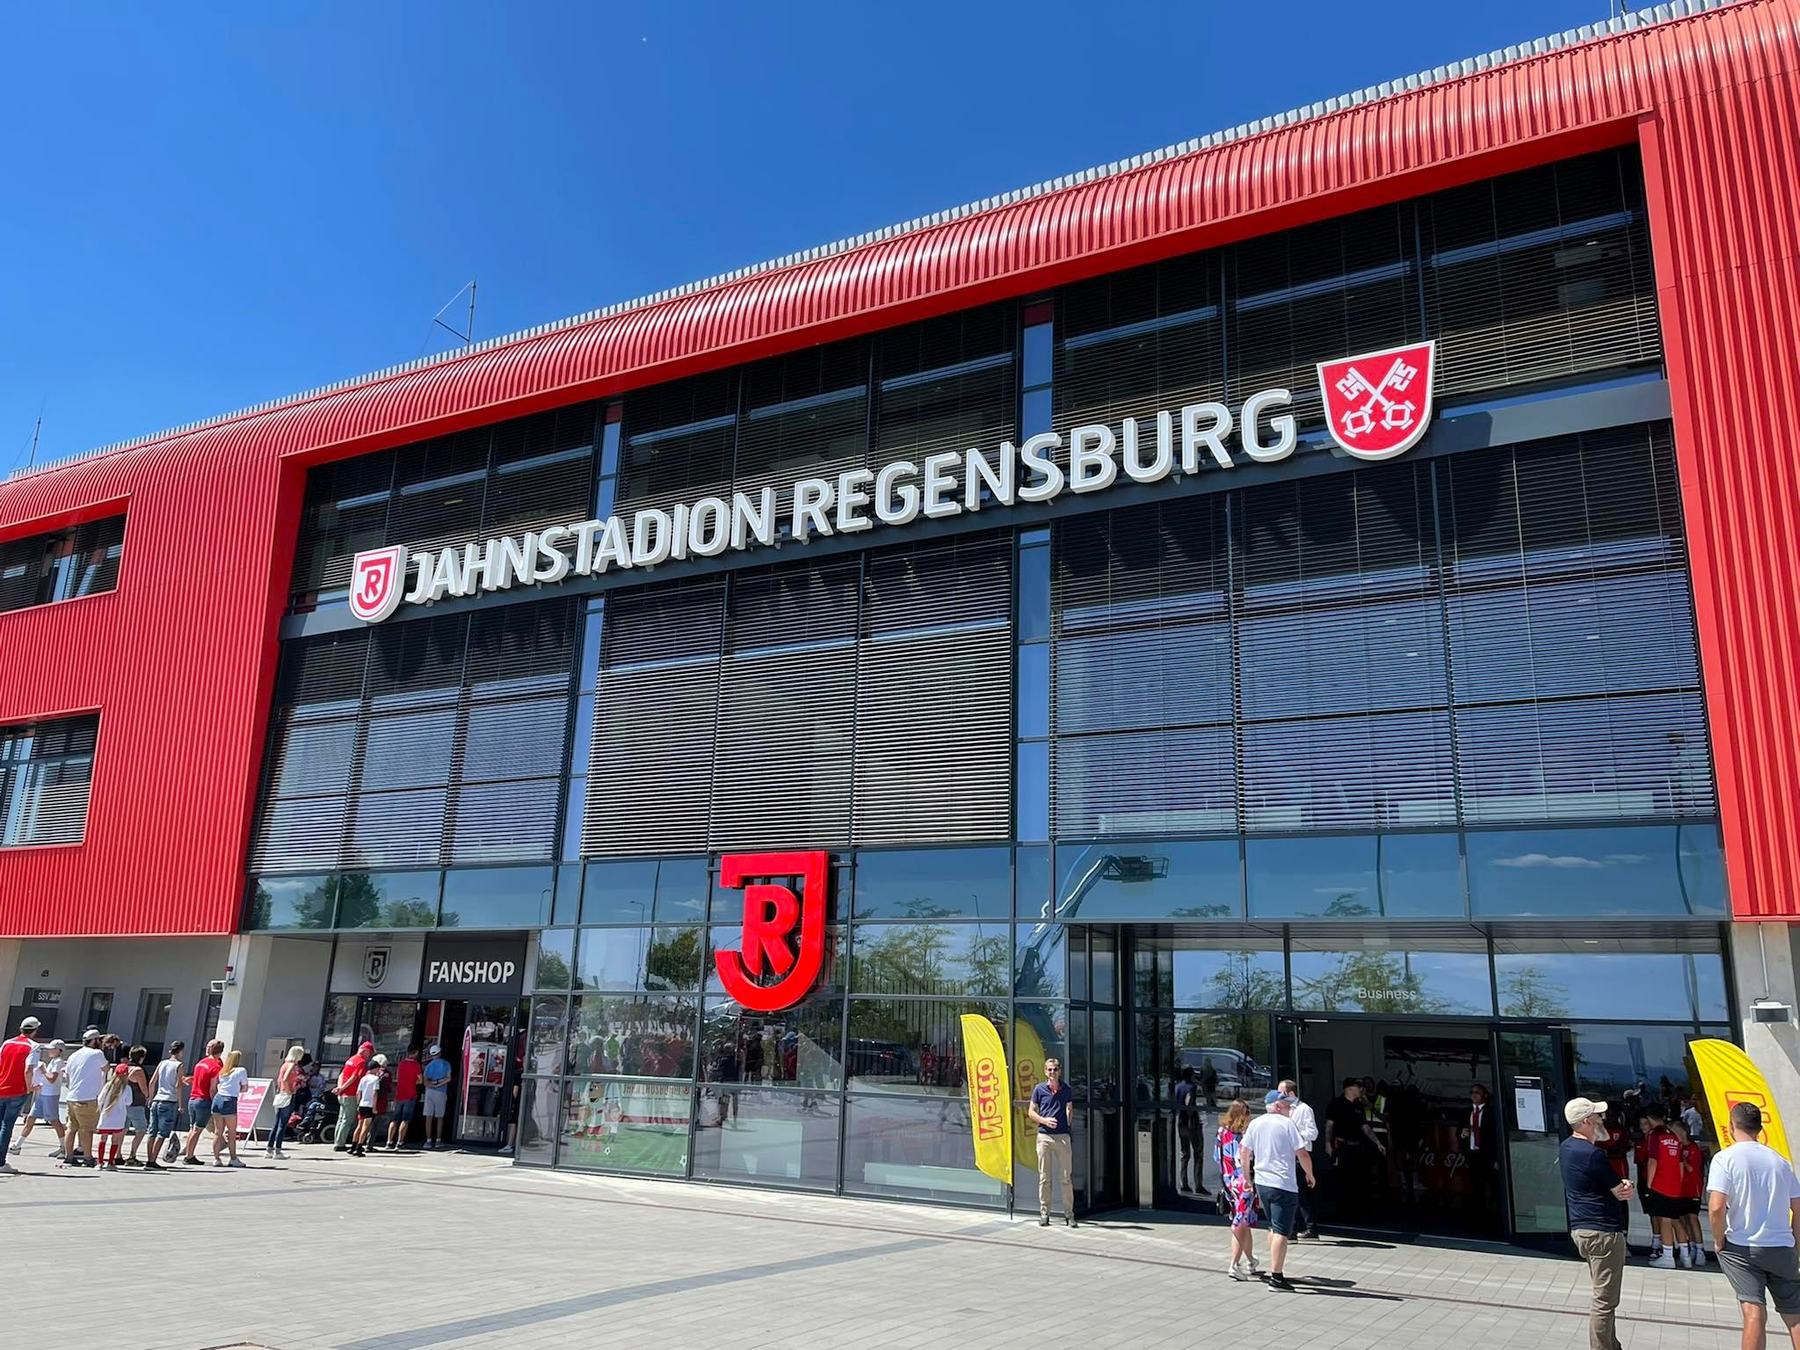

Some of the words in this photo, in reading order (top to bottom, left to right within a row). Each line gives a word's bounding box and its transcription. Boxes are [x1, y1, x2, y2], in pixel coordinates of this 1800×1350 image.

[404, 487, 775, 604] JAHNSTADION
[792, 388, 1297, 541] REGENSBURG
[428, 961, 515, 983] FANSHOP
[1358, 987, 1416, 1000] Business
